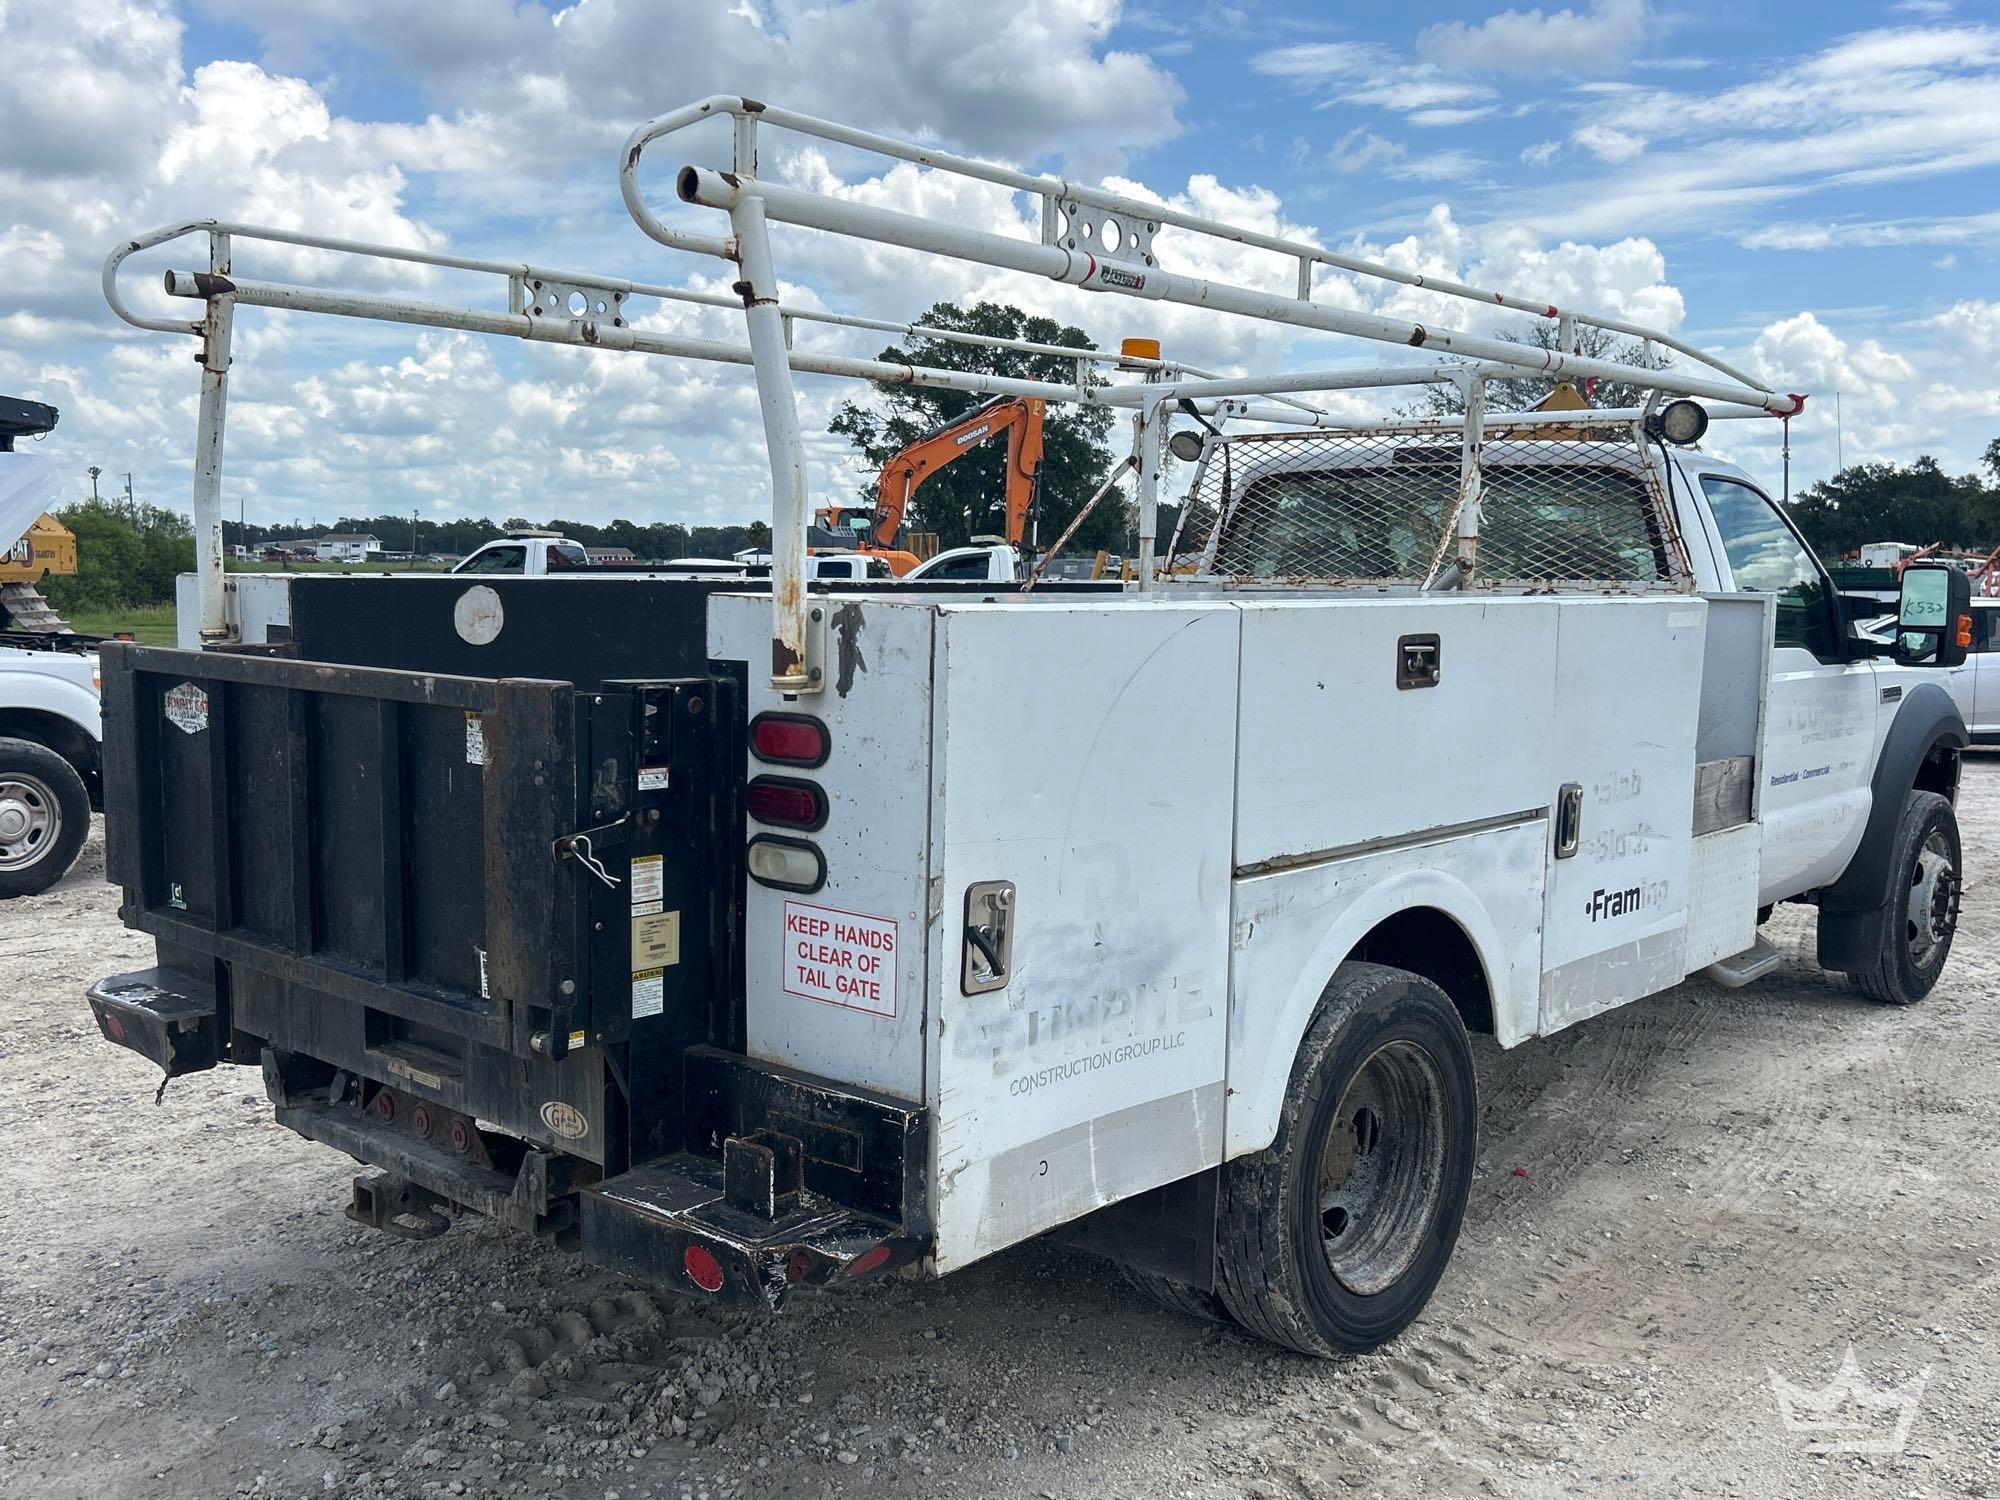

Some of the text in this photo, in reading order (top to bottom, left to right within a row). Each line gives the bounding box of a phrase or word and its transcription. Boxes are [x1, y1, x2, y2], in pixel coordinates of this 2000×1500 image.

[957, 425, 989, 445] DOOSAN
[11, 539, 29, 561] CAT
[1903, 597, 1945, 618] K532
[1770, 771, 1799, 787] Residential
[1802, 764, 1830, 780] Commercial
[787, 913, 894, 952] KEEP HANDS
[797, 941, 881, 974] CLEAR OF
[797, 965, 881, 1001] TAIL GATE
[1009, 1031, 1186, 1097] CONSTRUCTION GROUP LLC
